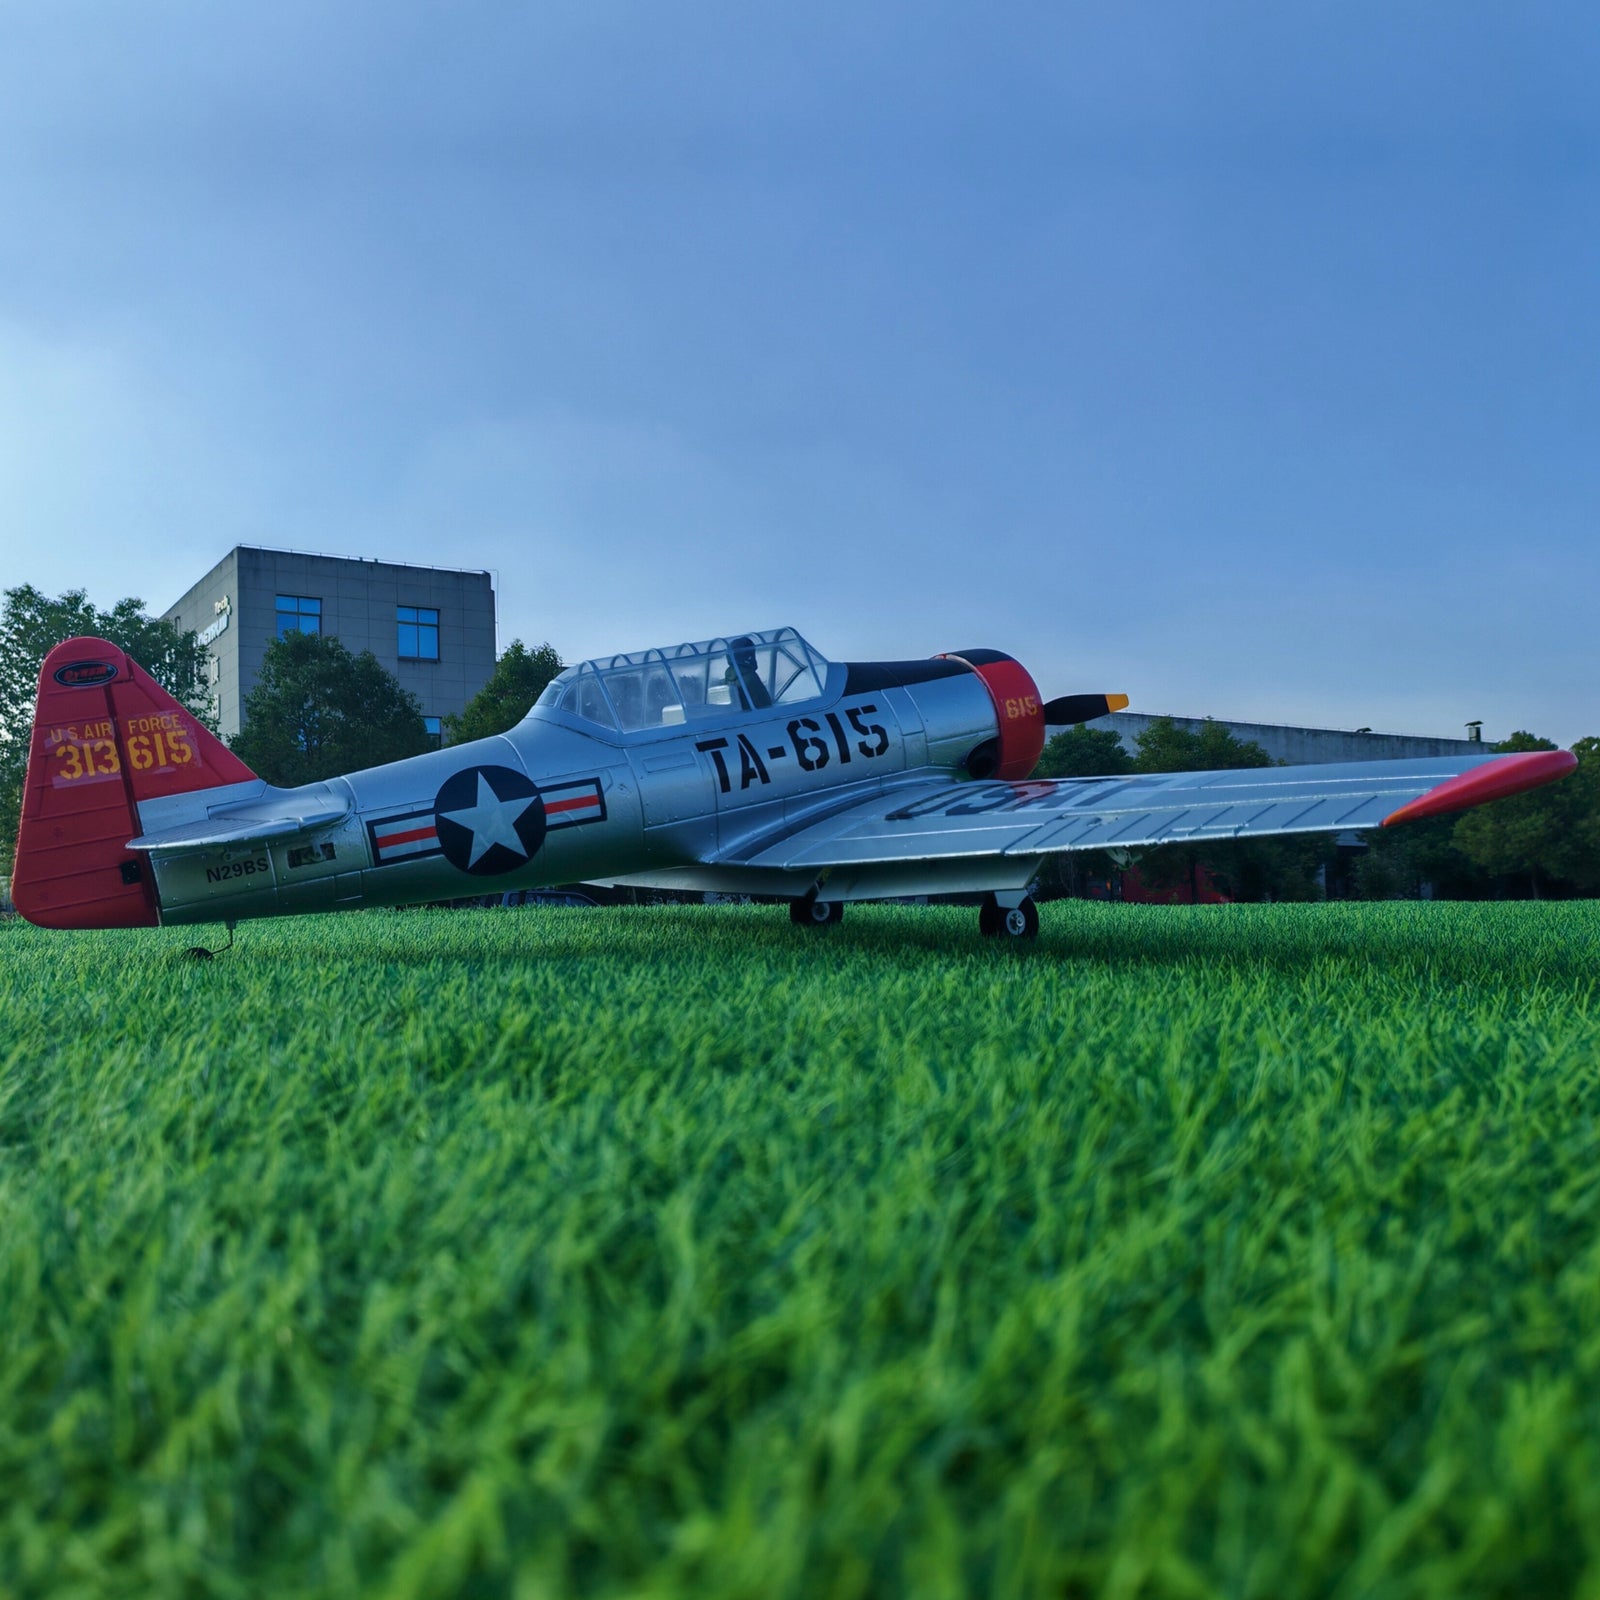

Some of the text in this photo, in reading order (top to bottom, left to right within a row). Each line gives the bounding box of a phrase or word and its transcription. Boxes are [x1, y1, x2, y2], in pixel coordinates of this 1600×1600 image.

[1005, 695, 1038, 719] 615
[84, 722, 112, 739] AIR
[128, 714, 182, 734] FORCE
[56, 730, 193, 780] 313 615
[694, 704, 889, 793] TA-615
[206, 858, 269, 883] N29BS
